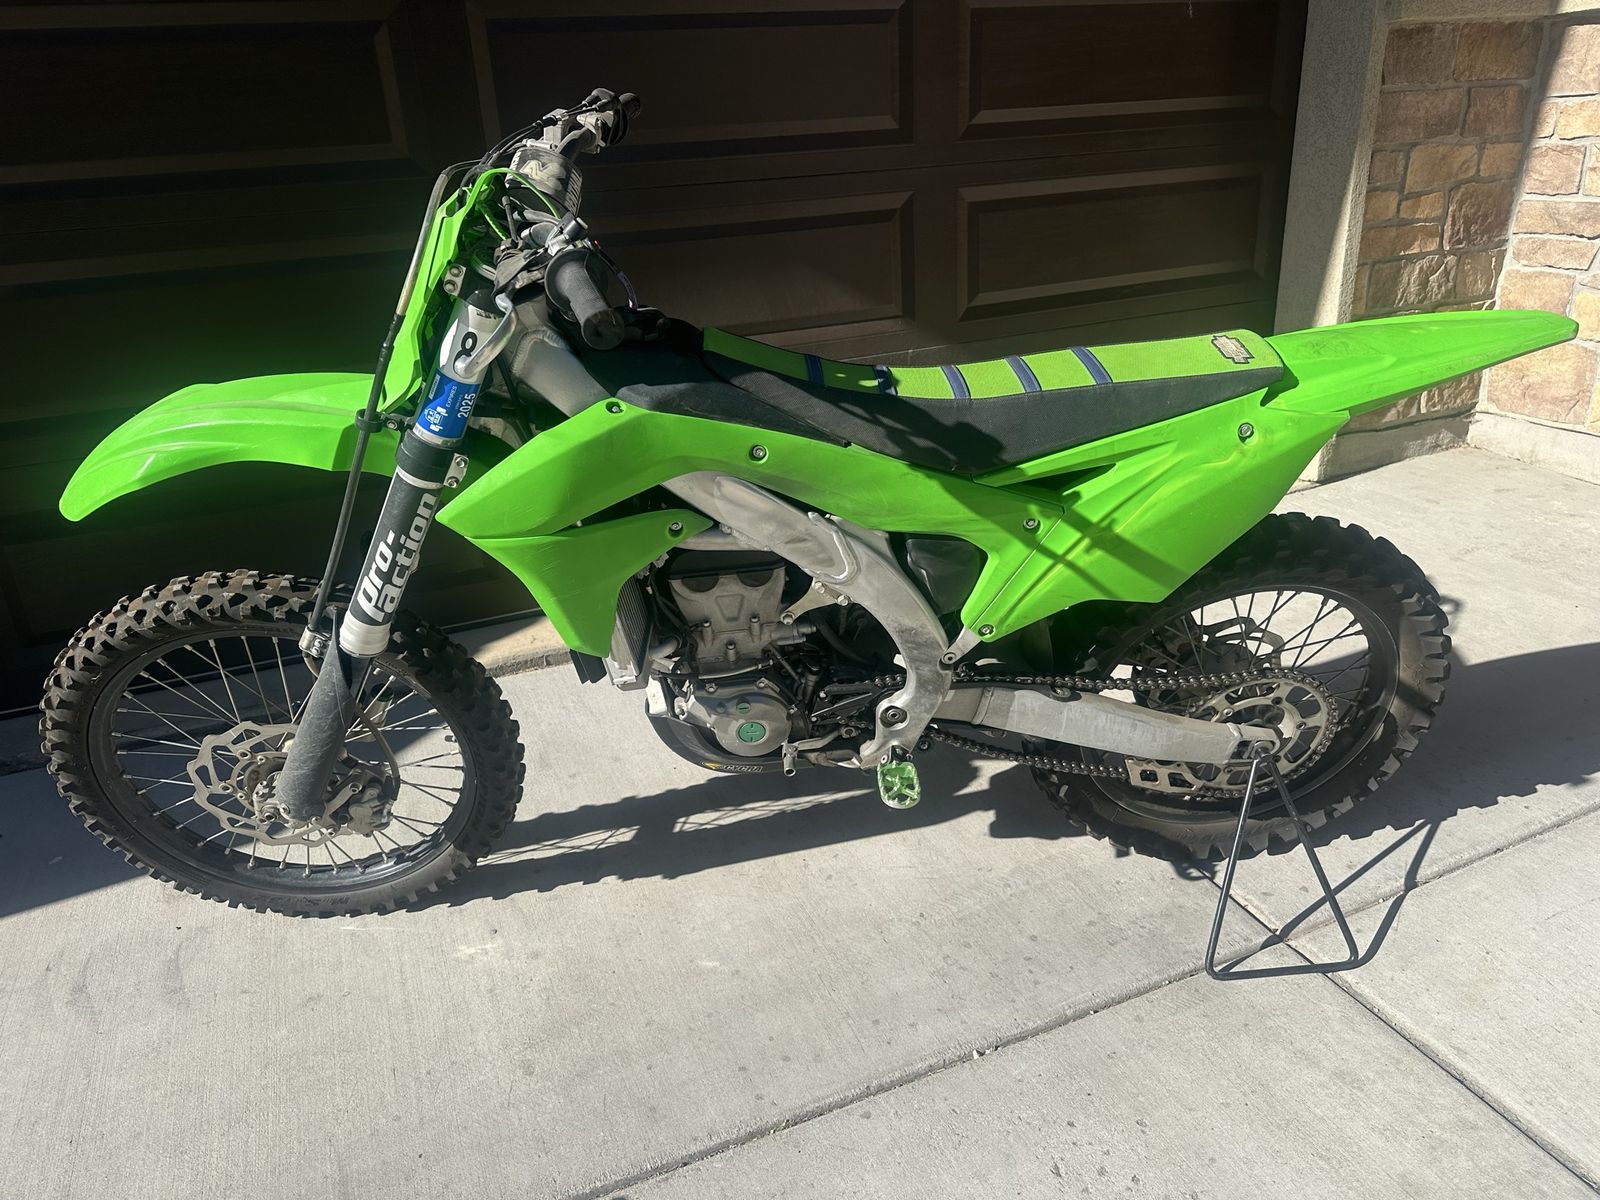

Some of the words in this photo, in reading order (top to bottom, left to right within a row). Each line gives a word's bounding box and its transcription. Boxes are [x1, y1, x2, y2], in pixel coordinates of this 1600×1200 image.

[445, 385, 458, 408] EXPIRES
[457, 392, 476, 419] 2025
[357, 529, 395, 623] pro-
[376, 492, 437, 613] action
